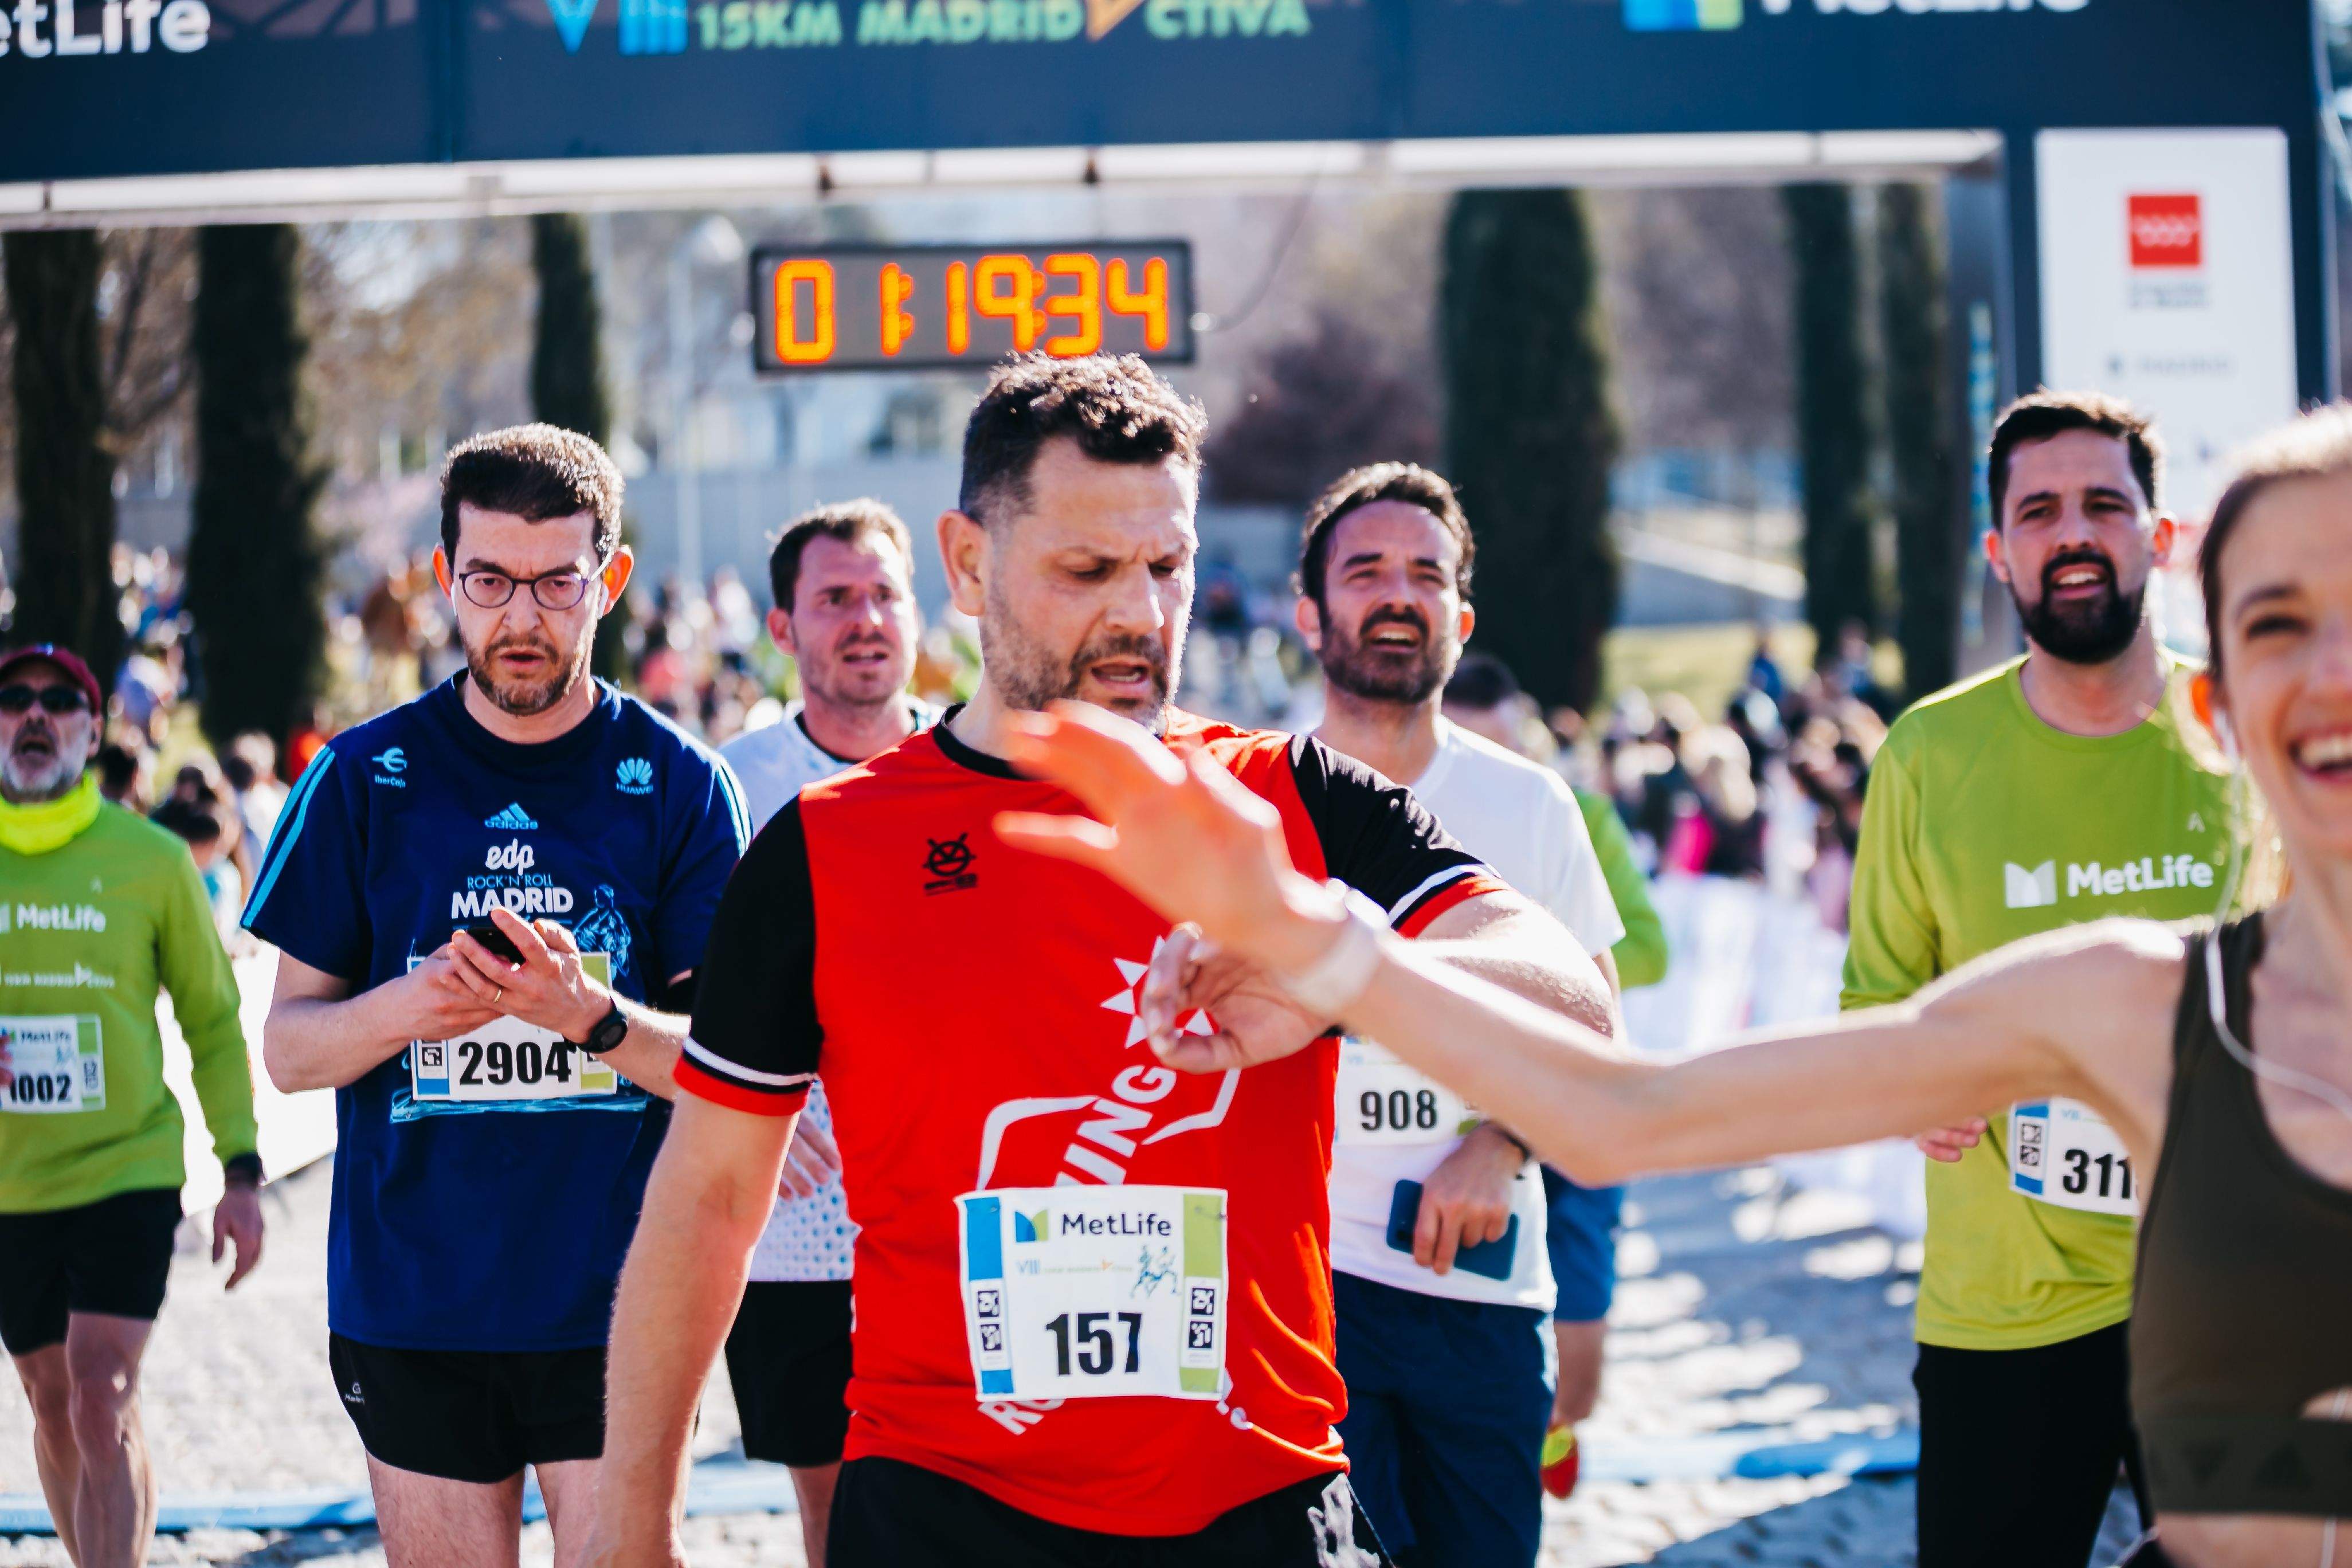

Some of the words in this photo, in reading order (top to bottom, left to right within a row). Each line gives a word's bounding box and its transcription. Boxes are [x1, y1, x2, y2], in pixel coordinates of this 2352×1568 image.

[0, 0, 211, 58] tLife
[696, 0, 838, 49] 15KM
[856, 0, 1085, 45] MADRID
[616, 782, 653, 795] HUAWEI
[484, 820, 538, 829] adidas
[485, 837, 535, 876] edp
[2067, 854, 2214, 897] MetLife
[16, 903, 107, 933] MetLife
[451, 887, 574, 919] MADRID
[458, 1041, 572, 1085] 2904
[1360, 1089, 1438, 1131] 908
[1061, 1212, 1172, 1237] MetLife
[1045, 1312, 1144, 1377] 157
